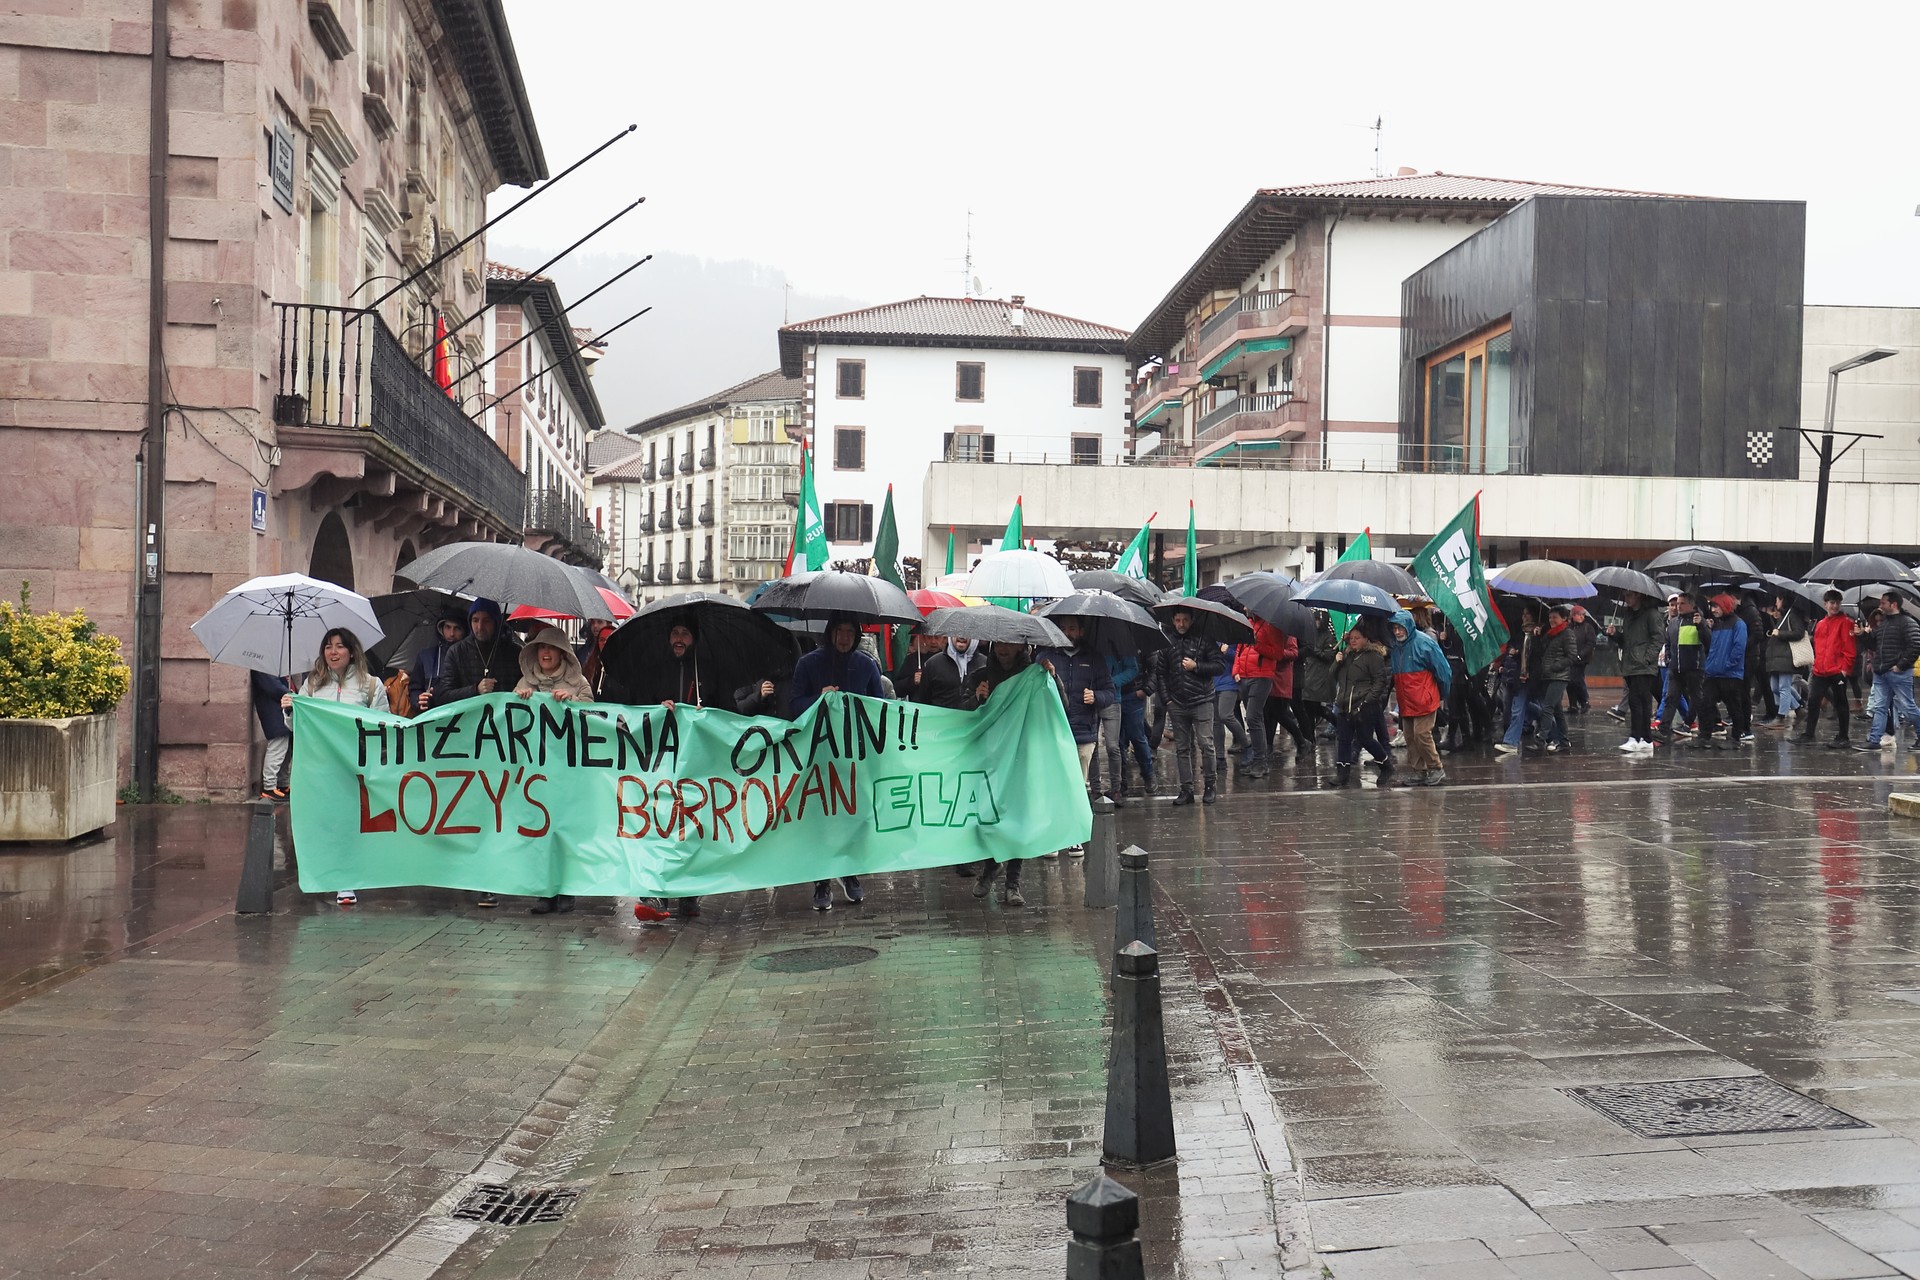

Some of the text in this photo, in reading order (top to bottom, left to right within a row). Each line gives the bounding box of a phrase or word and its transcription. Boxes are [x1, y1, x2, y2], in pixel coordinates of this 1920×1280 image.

[1430, 554, 1452, 589] EUSKAL
[355, 695, 919, 777] HITZARMENA OKAIN!!
[357, 762, 1000, 843] LOZY'S BORROKAN ELA
